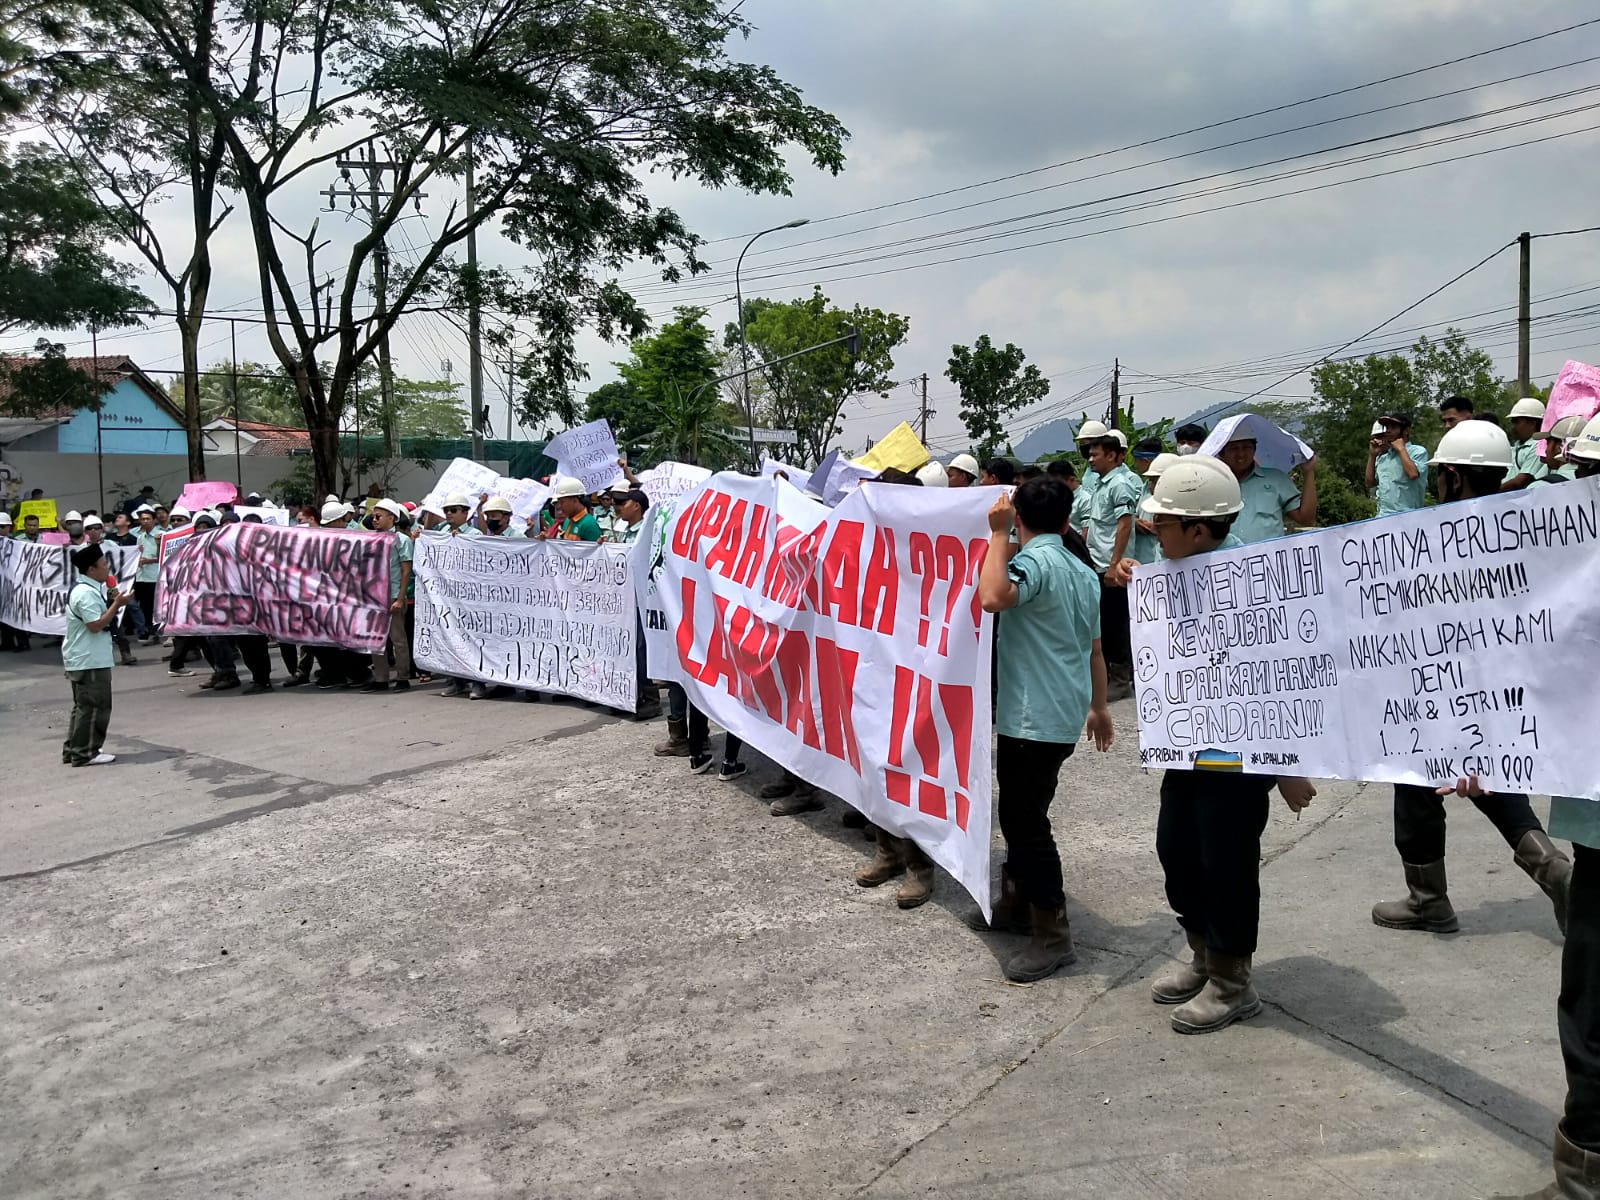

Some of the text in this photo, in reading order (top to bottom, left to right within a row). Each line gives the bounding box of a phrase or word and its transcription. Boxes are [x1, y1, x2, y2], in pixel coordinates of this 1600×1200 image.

[236, 526, 298, 566] UPAH
[297, 535, 386, 576] MURAH
[496, 551, 531, 575] DAN
[672, 488, 771, 590] UPAH
[1341, 500, 1597, 587] SAATNYA PERUSAHAAN
[237, 559, 292, 601] UPAH
[298, 572, 391, 608] LAYAK
[486, 583, 521, 605] KAMI
[526, 587, 569, 612] ADALAH
[1136, 545, 1324, 623] KAMI MEMENUHI
[422, 600, 451, 630] HAK
[456, 606, 493, 634] KAMI
[499, 612, 553, 640] ADALAH
[559, 619, 596, 647] UPAH
[1168, 605, 1288, 659] KEWAJIBAN
[1349, 607, 1555, 669] NAIKAN UPAH KAMI
[1164, 653, 1338, 704] UPAH KAMI HANYA
[1208, 650, 1230, 676] tapi
[1411, 661, 1465, 696] DEMI
[1383, 698, 1422, 725] ANAK
[1426, 700, 1439, 720] &
[1449, 690, 1500, 717] ISTRI
[1139, 747, 1184, 765] #PRIBUMI
[1424, 757, 1459, 781] NAIK
[1462, 755, 1495, 777] GAJI
